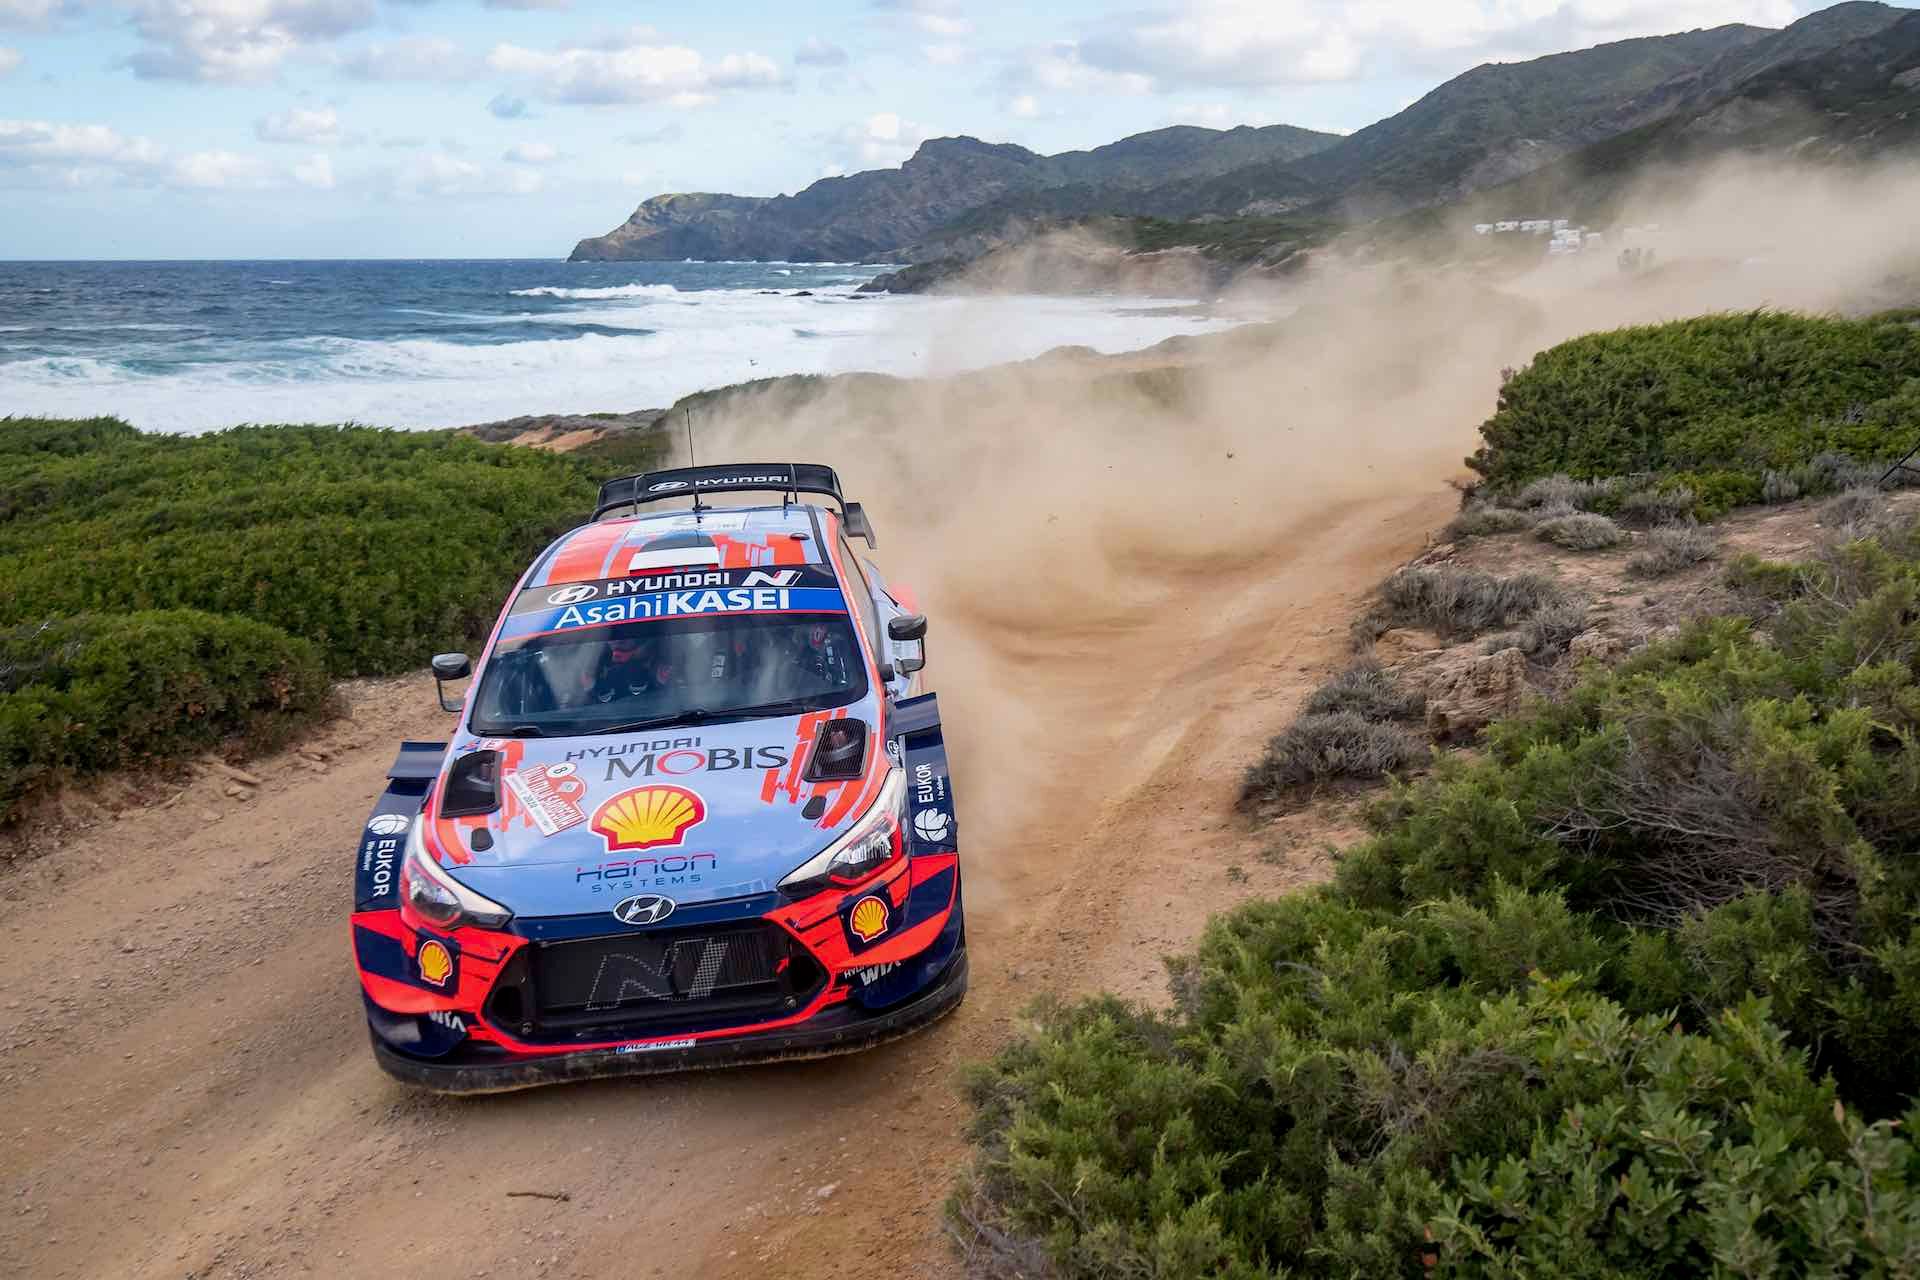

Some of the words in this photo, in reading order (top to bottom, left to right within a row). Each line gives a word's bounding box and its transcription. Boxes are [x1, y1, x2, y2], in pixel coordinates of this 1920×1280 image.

[696, 476, 788, 486] HYUNDAI
[607, 572, 730, 596] HYUNDAI
[566, 737, 701, 761] HYUNDAI
[604, 746, 789, 781] MOBIS
[916, 763, 934, 804] EUKOR
[373, 839, 397, 896] EUKOR
[591, 874, 703, 893] SYSTEMS
